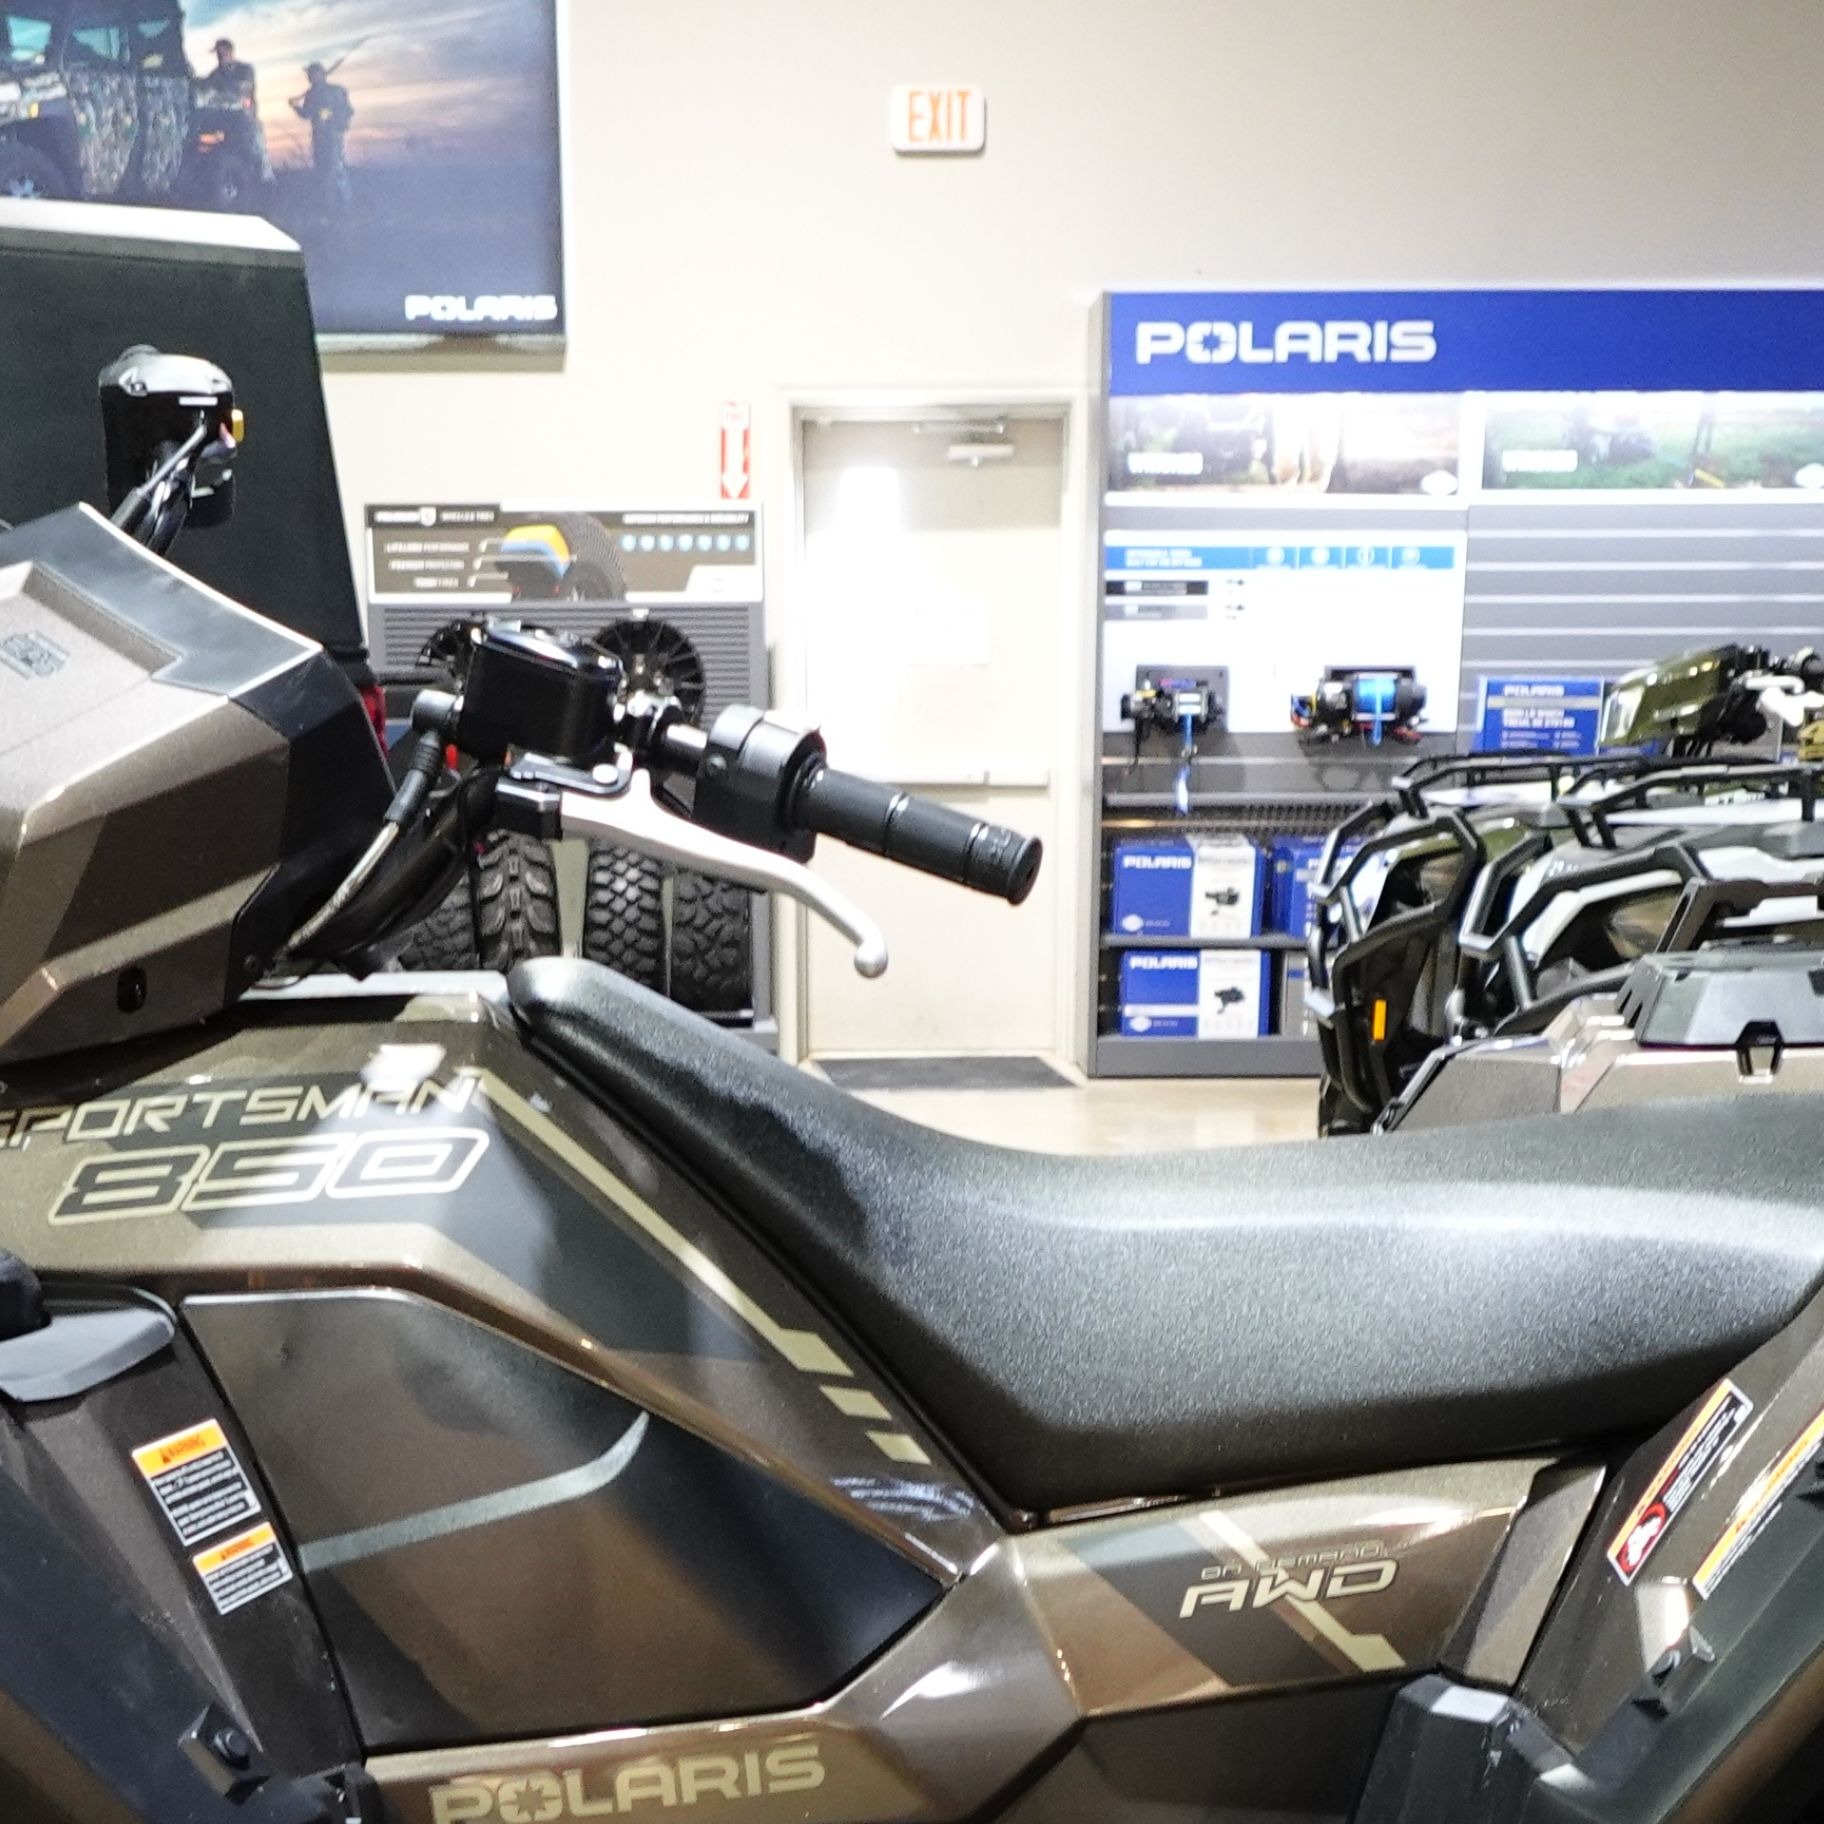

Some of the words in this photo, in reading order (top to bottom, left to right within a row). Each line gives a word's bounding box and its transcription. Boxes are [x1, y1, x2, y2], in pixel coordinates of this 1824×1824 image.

[907, 90, 972, 142] EXIT
[405, 294, 558, 321] POLARIS
[1134, 320, 1437, 365] POLARIS
[48, 1127, 490, 1226] 850
[1179, 1559, 1401, 1618] AWD
